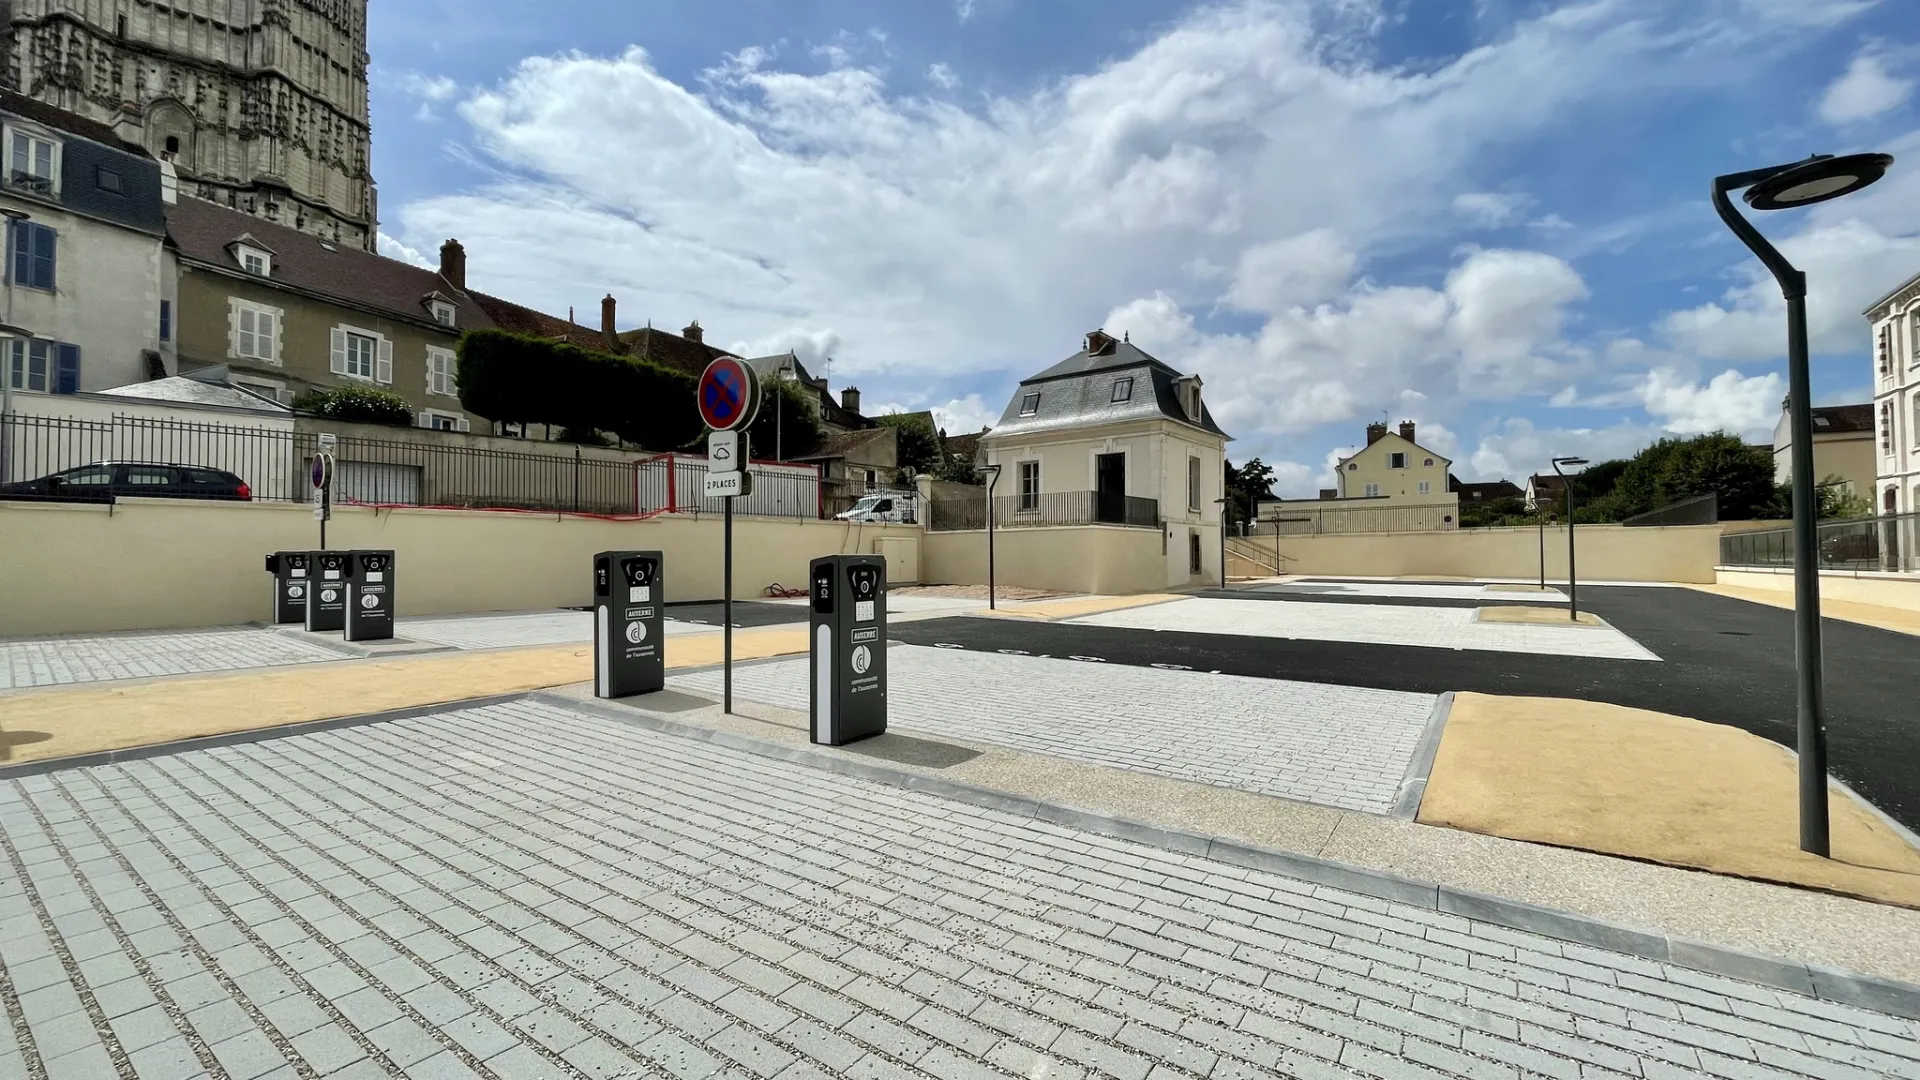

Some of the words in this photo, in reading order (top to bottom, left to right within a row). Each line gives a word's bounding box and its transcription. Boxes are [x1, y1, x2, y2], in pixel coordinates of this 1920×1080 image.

[707, 481, 711, 489] 2
[712, 479, 736, 489] PLACES
[628, 609, 652, 617] AUXERRE
[854, 630, 876, 640] AUXERRE
